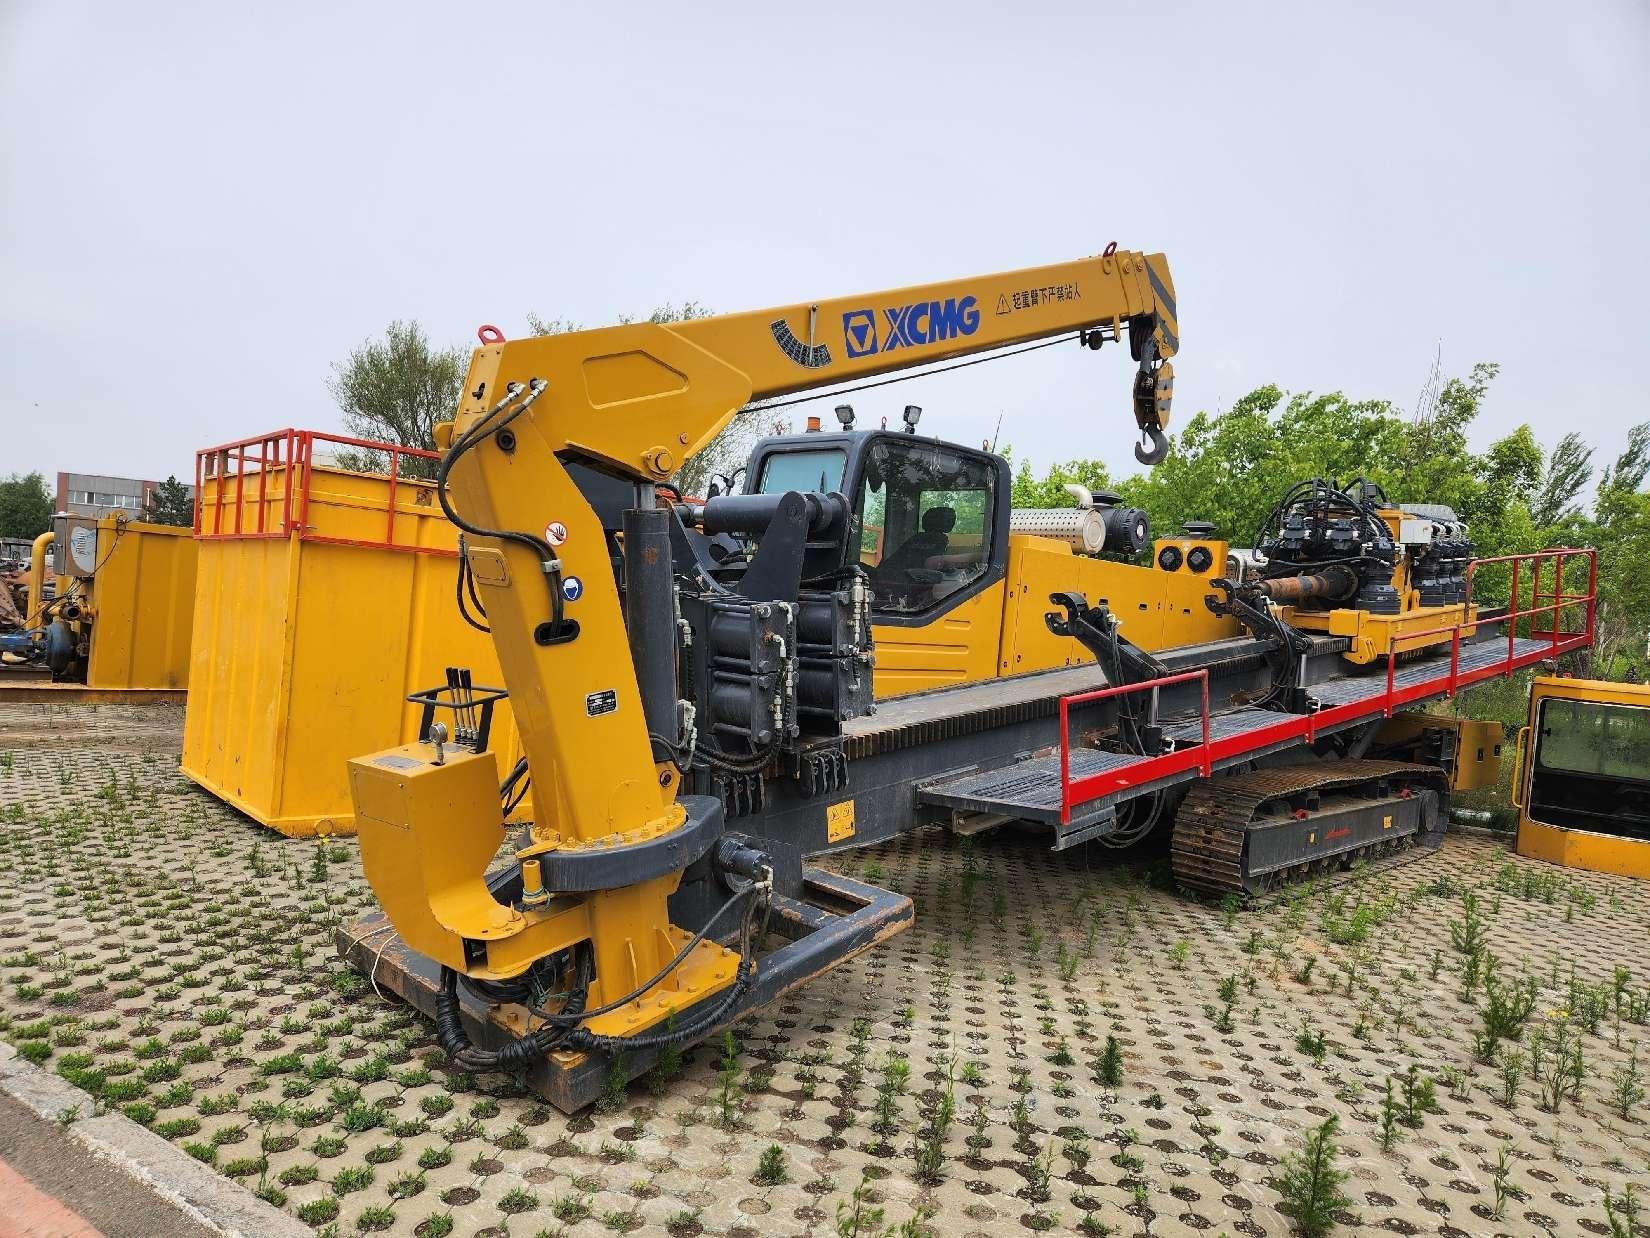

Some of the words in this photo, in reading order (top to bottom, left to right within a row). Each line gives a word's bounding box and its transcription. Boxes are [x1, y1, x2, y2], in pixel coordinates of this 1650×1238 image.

[1012, 282, 1081, 310] 起重臂下严禁站人
[881, 296, 980, 352] XCMG
